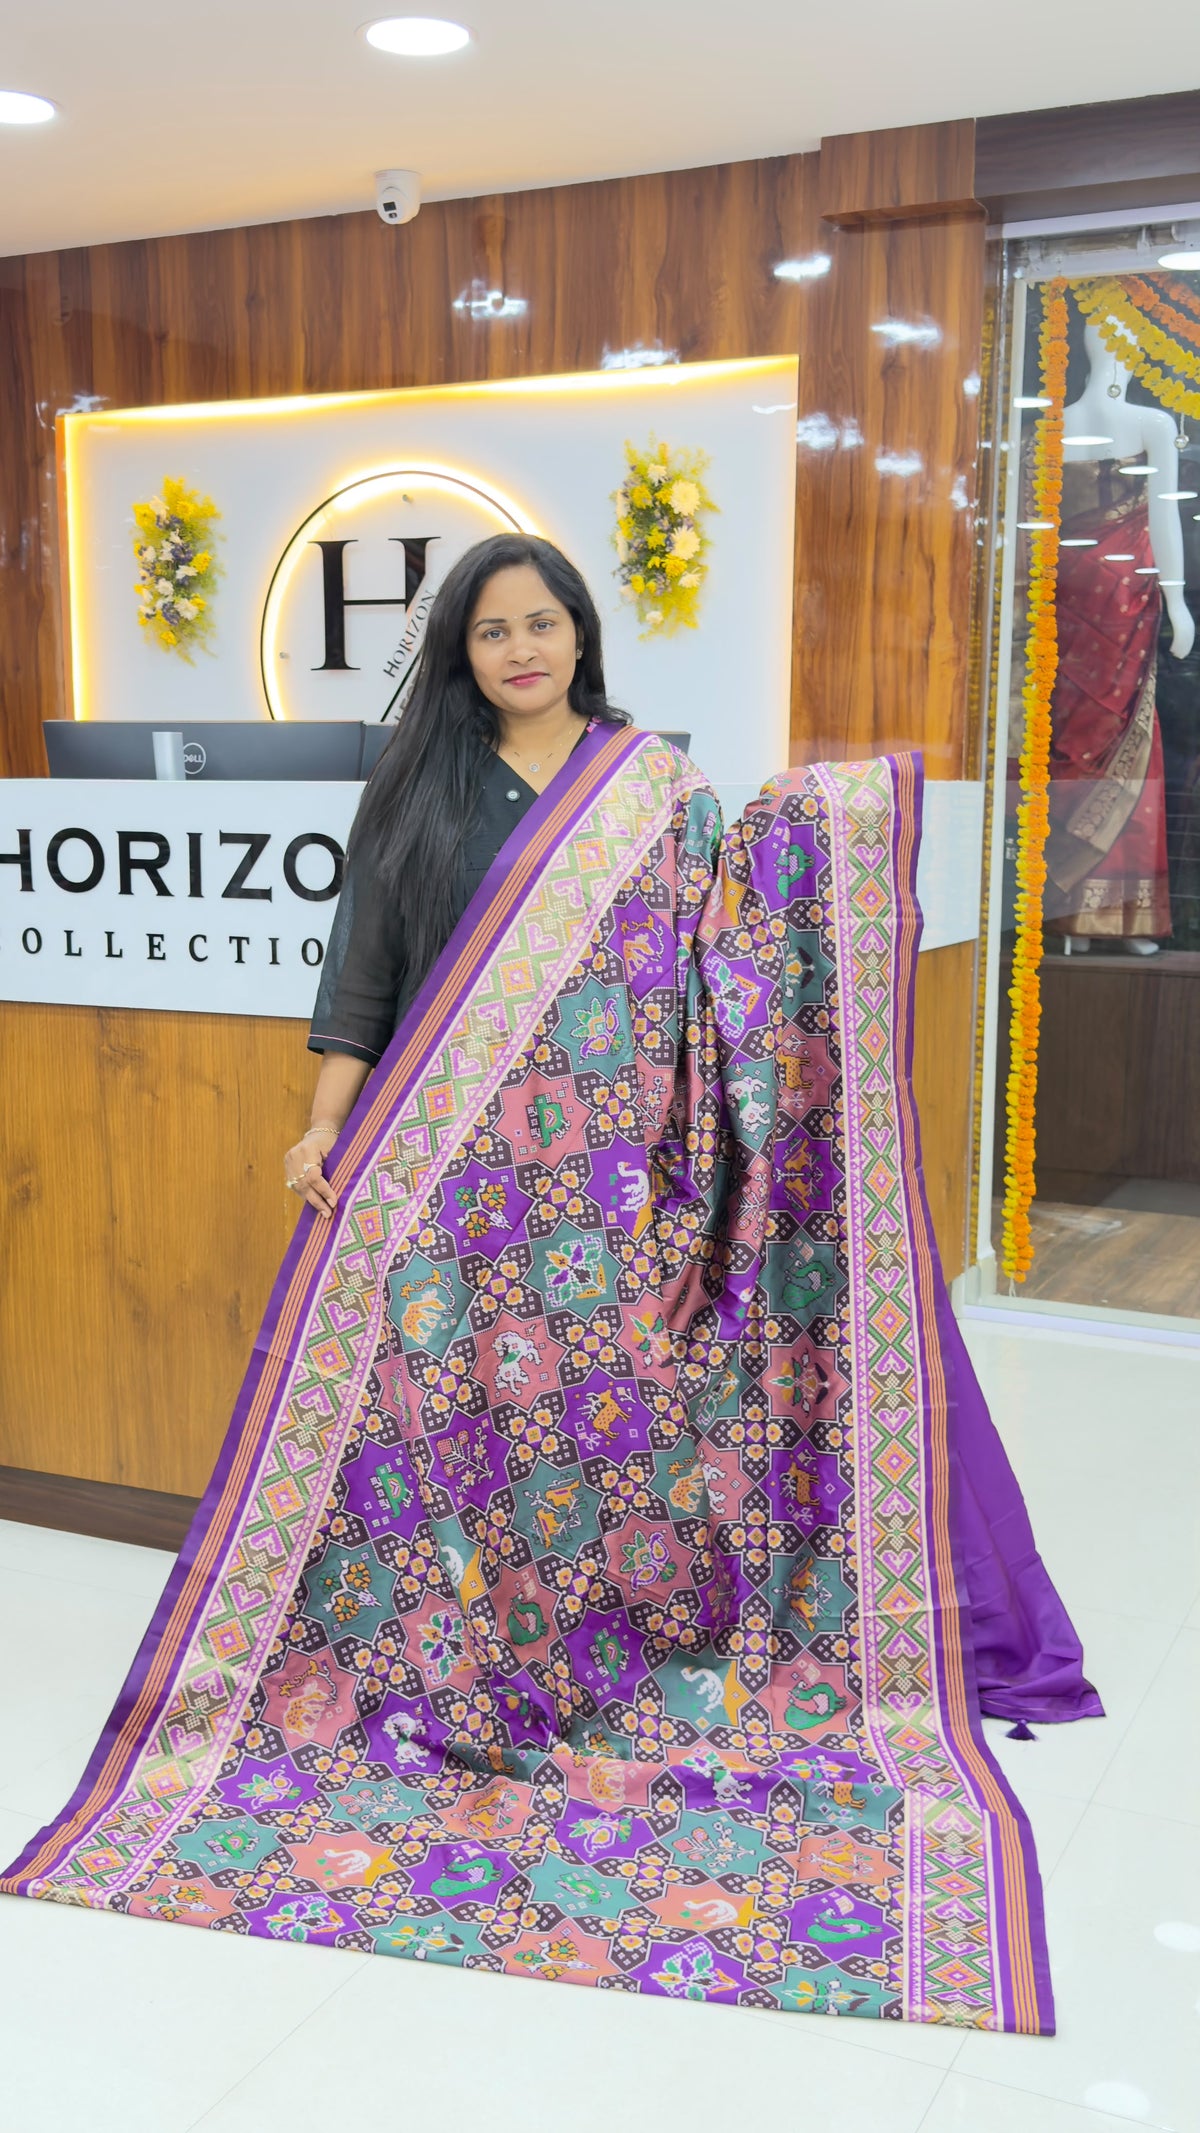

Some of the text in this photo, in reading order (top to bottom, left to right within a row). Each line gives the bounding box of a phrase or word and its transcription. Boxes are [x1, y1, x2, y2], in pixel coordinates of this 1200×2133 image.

[307, 536, 441, 671] H
[383, 589, 436, 678] HORIZON
[183, 753, 203, 763] DELL
[0, 827, 346, 902] HORIZO
[0, 927, 324, 967] OLLECTIO
